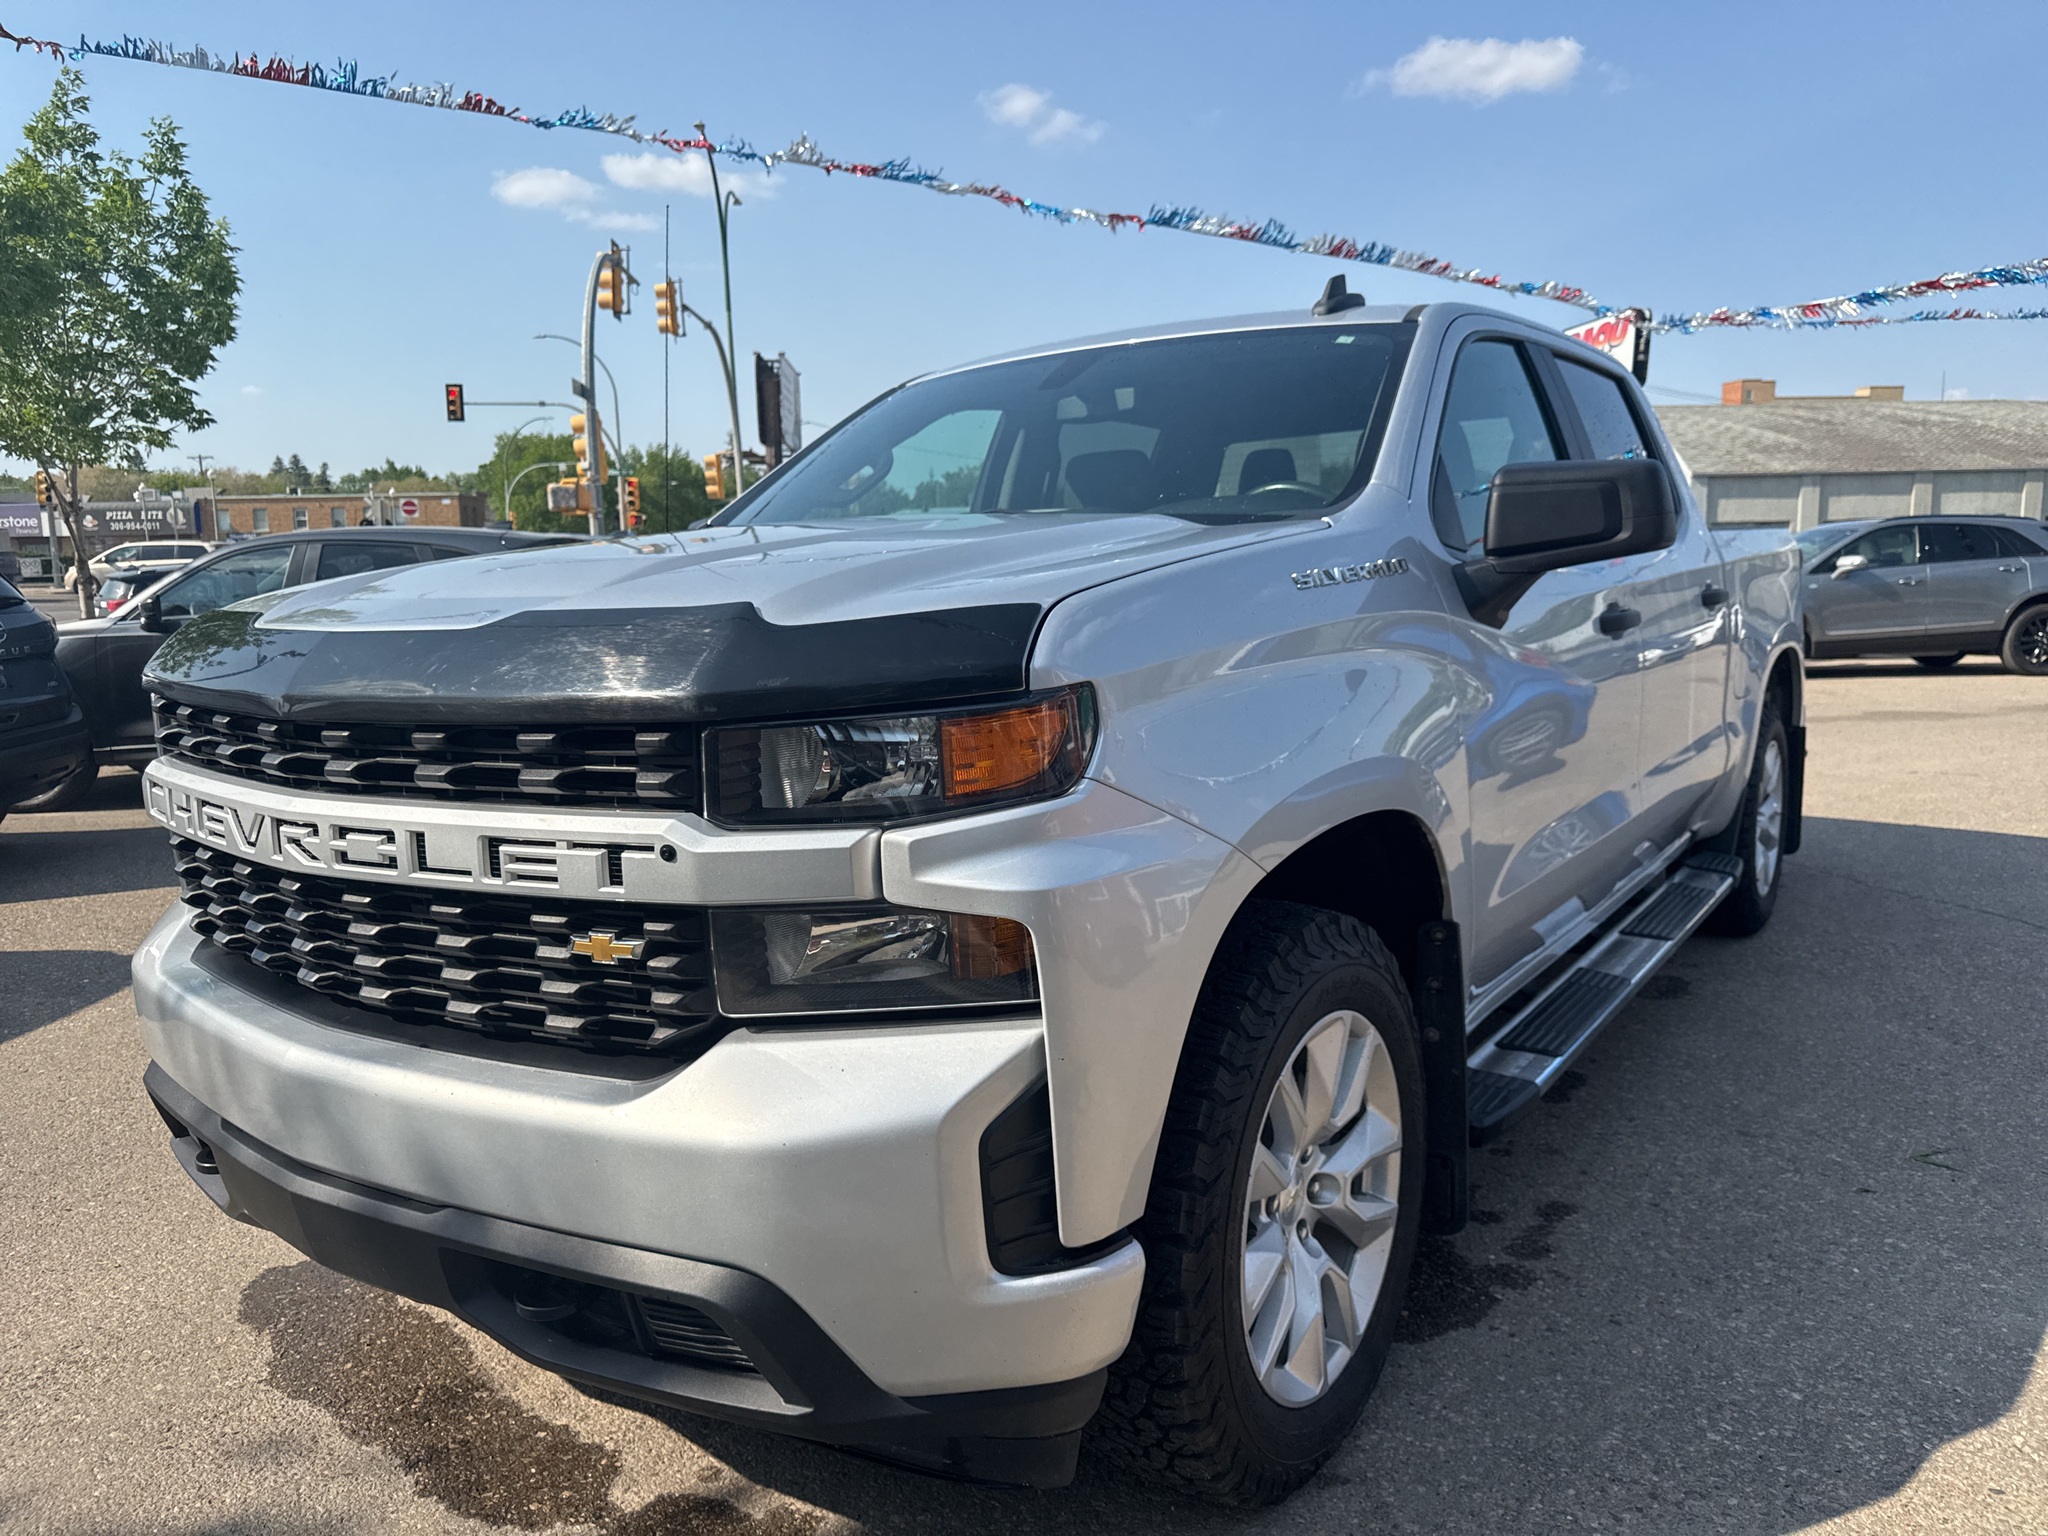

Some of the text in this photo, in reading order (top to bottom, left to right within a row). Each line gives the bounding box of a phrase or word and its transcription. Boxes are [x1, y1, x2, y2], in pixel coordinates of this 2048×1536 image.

[105, 510, 134, 520] PIZZA
[1290, 557, 1409, 590] SILVERADO
[145, 778, 657, 895] CHEVROLET
